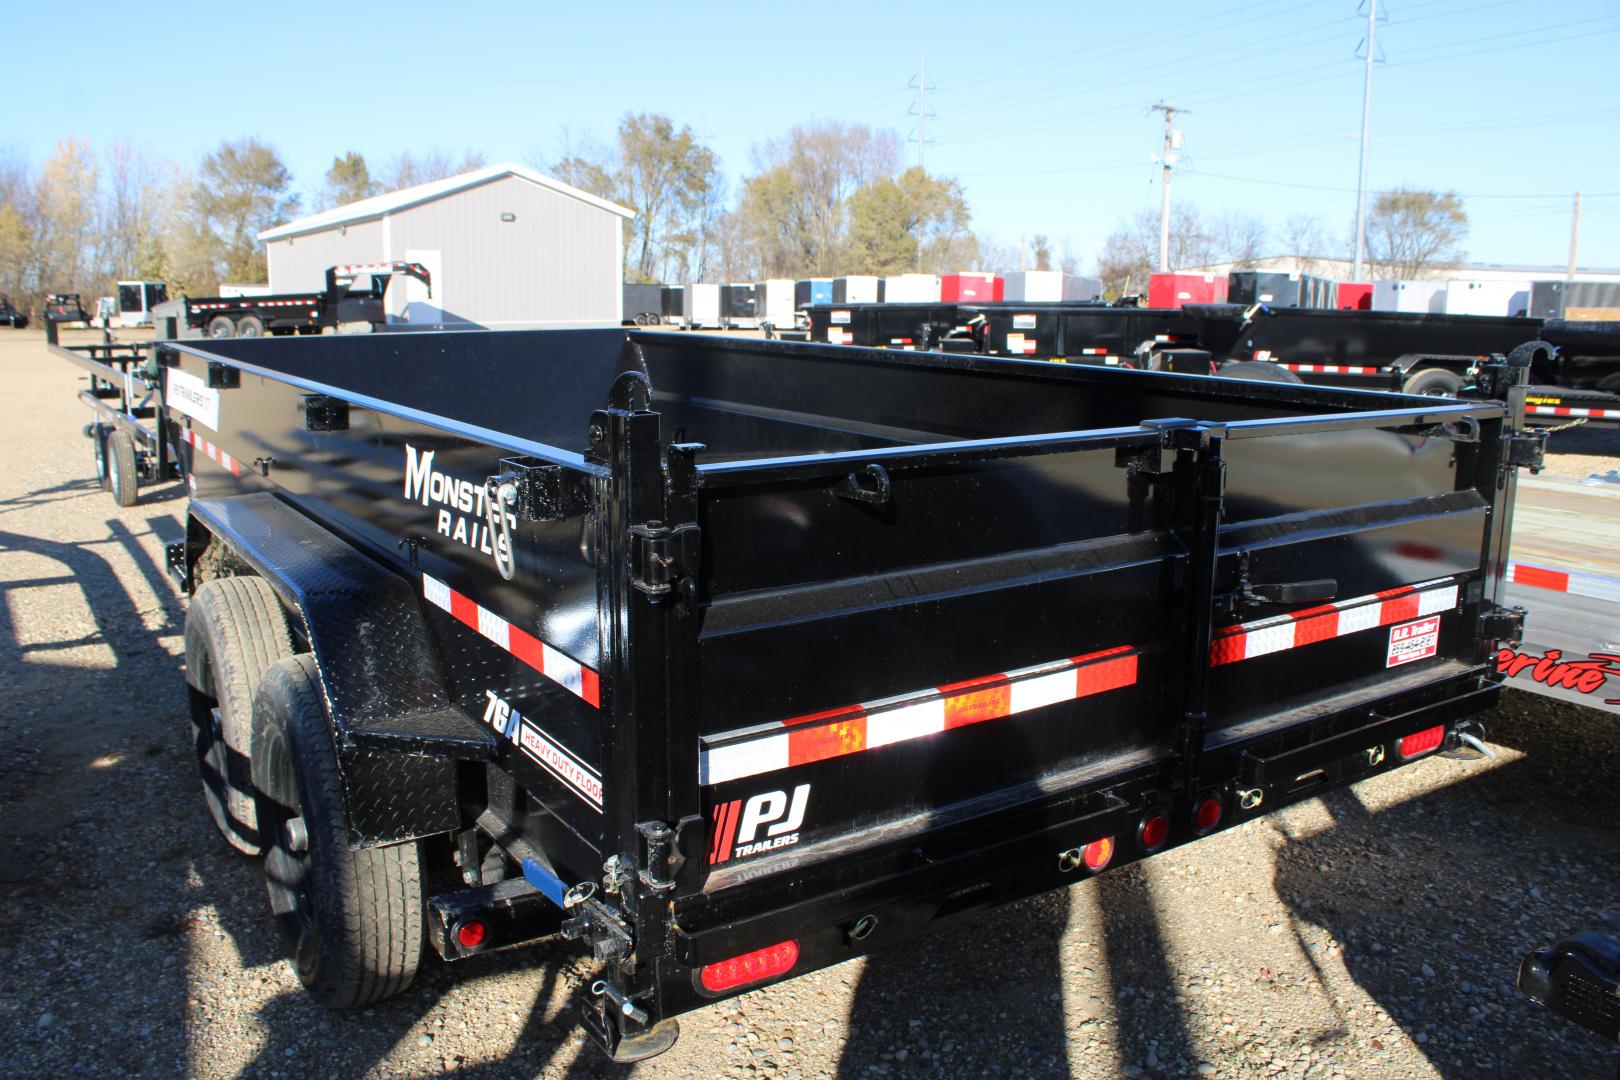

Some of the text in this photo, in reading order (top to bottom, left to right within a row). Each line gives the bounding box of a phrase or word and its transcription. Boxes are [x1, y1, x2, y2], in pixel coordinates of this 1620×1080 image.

[1411, 622, 1437, 637] Trailer
[483, 689, 521, 747] 7GA
[525, 730, 551, 759] HEAVY
[552, 752, 575, 779] DUTY
[737, 783, 812, 845] PJ
[734, 832, 800, 858] TRAILERS
